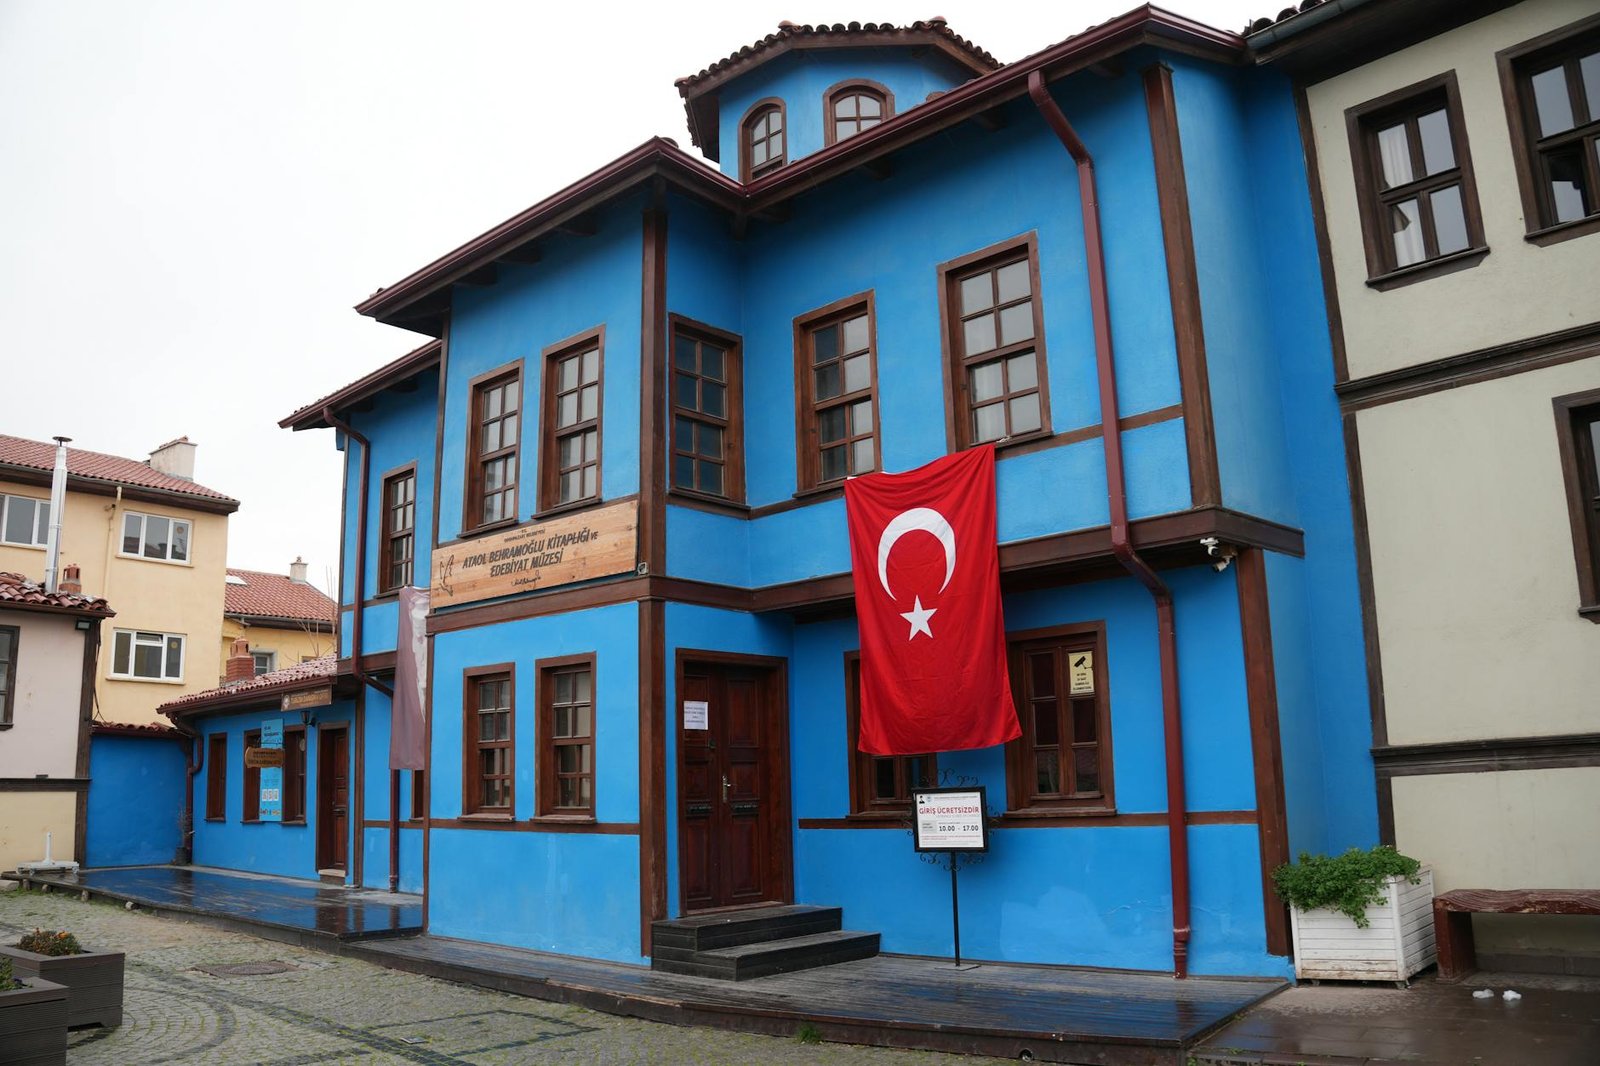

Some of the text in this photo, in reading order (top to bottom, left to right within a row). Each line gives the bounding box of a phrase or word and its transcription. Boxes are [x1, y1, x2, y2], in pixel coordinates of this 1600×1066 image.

[462, 527, 599, 569] ATAOL BEHRAMOĞLU KİTAPLIĞI VE
[490, 548, 564, 578] EDEBİYAT MÜZESİ
[919, 806, 979, 815] GİRİŞ ÜCRETSİZDİR
